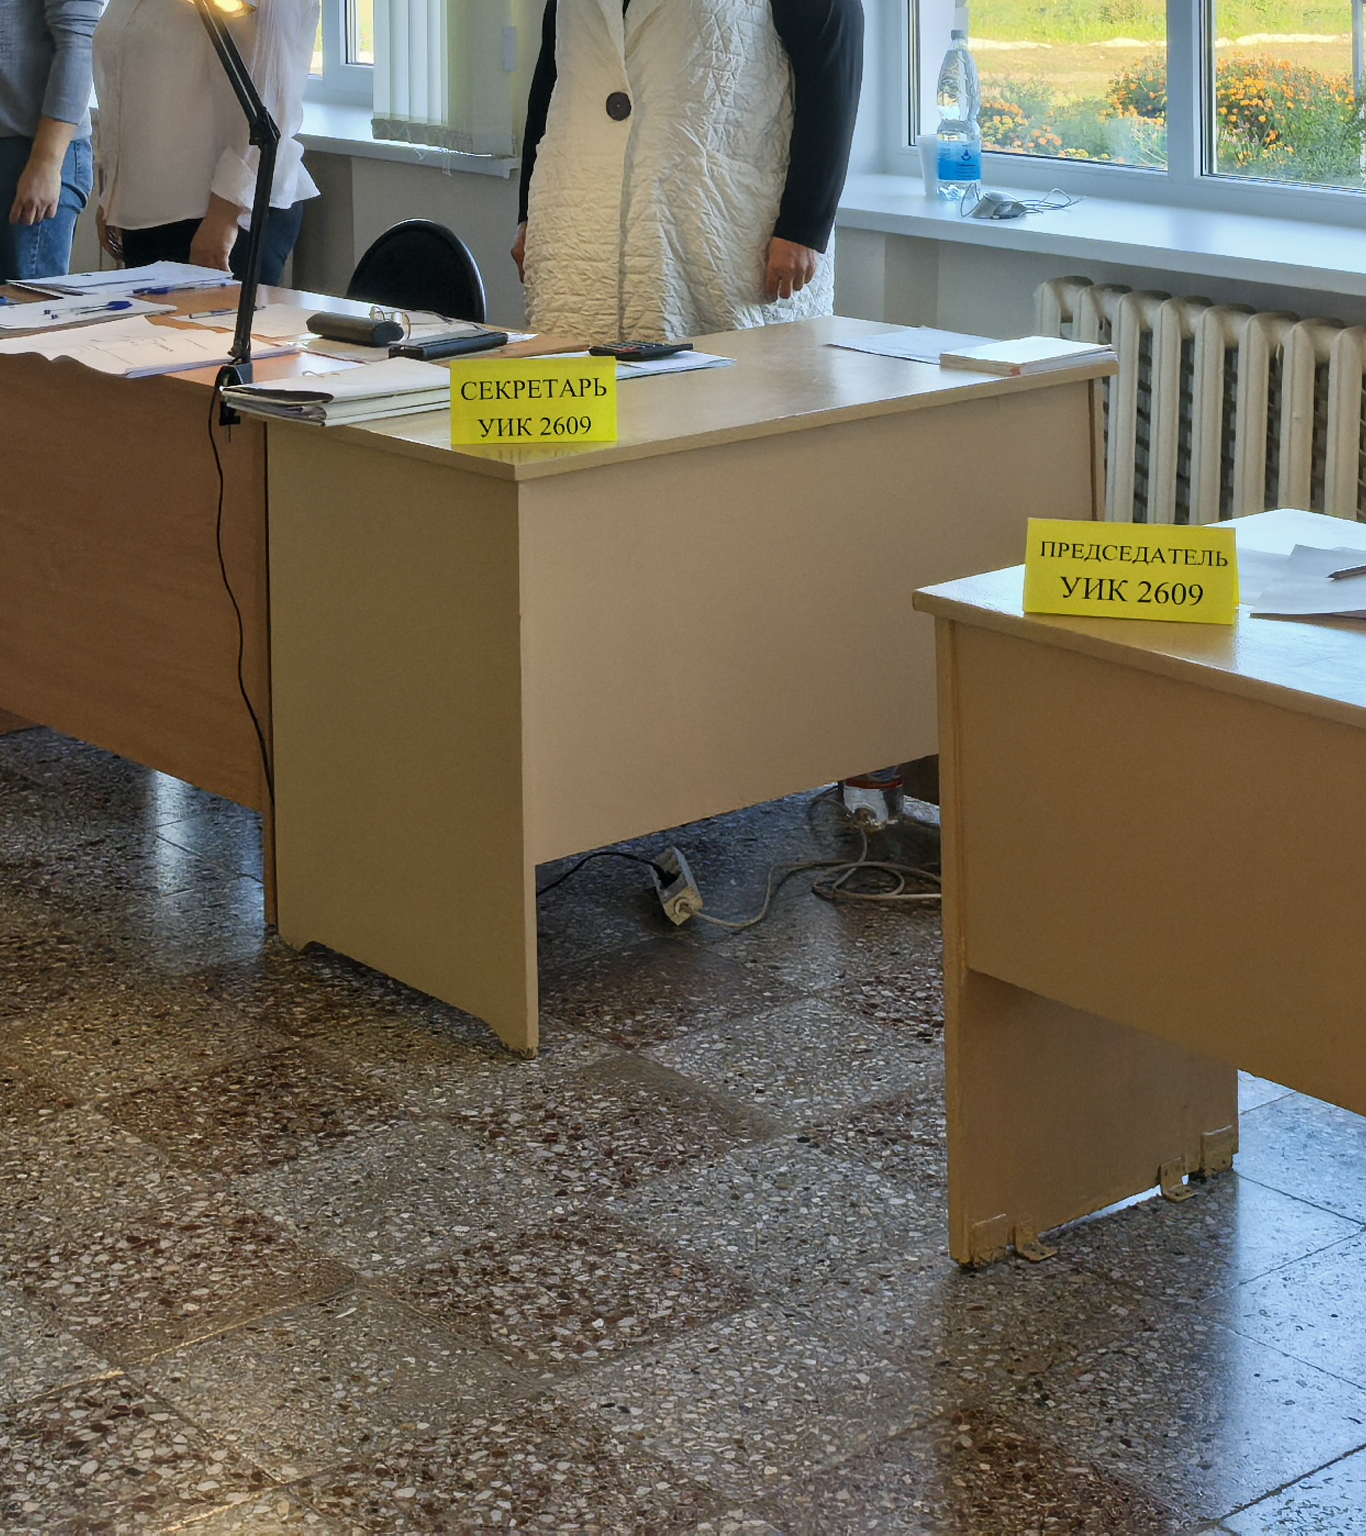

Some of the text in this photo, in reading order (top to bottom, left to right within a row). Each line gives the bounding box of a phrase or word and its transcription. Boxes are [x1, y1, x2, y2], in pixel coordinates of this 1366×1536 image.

[461, 378, 607, 401] СЕКРЕТАРЬ
[478, 416, 592, 438] УИК 2609
[1040, 541, 1229, 568] ПРЕДСЕДАТЕЛЬ
[1060, 576, 1204, 606] УИК 2609
